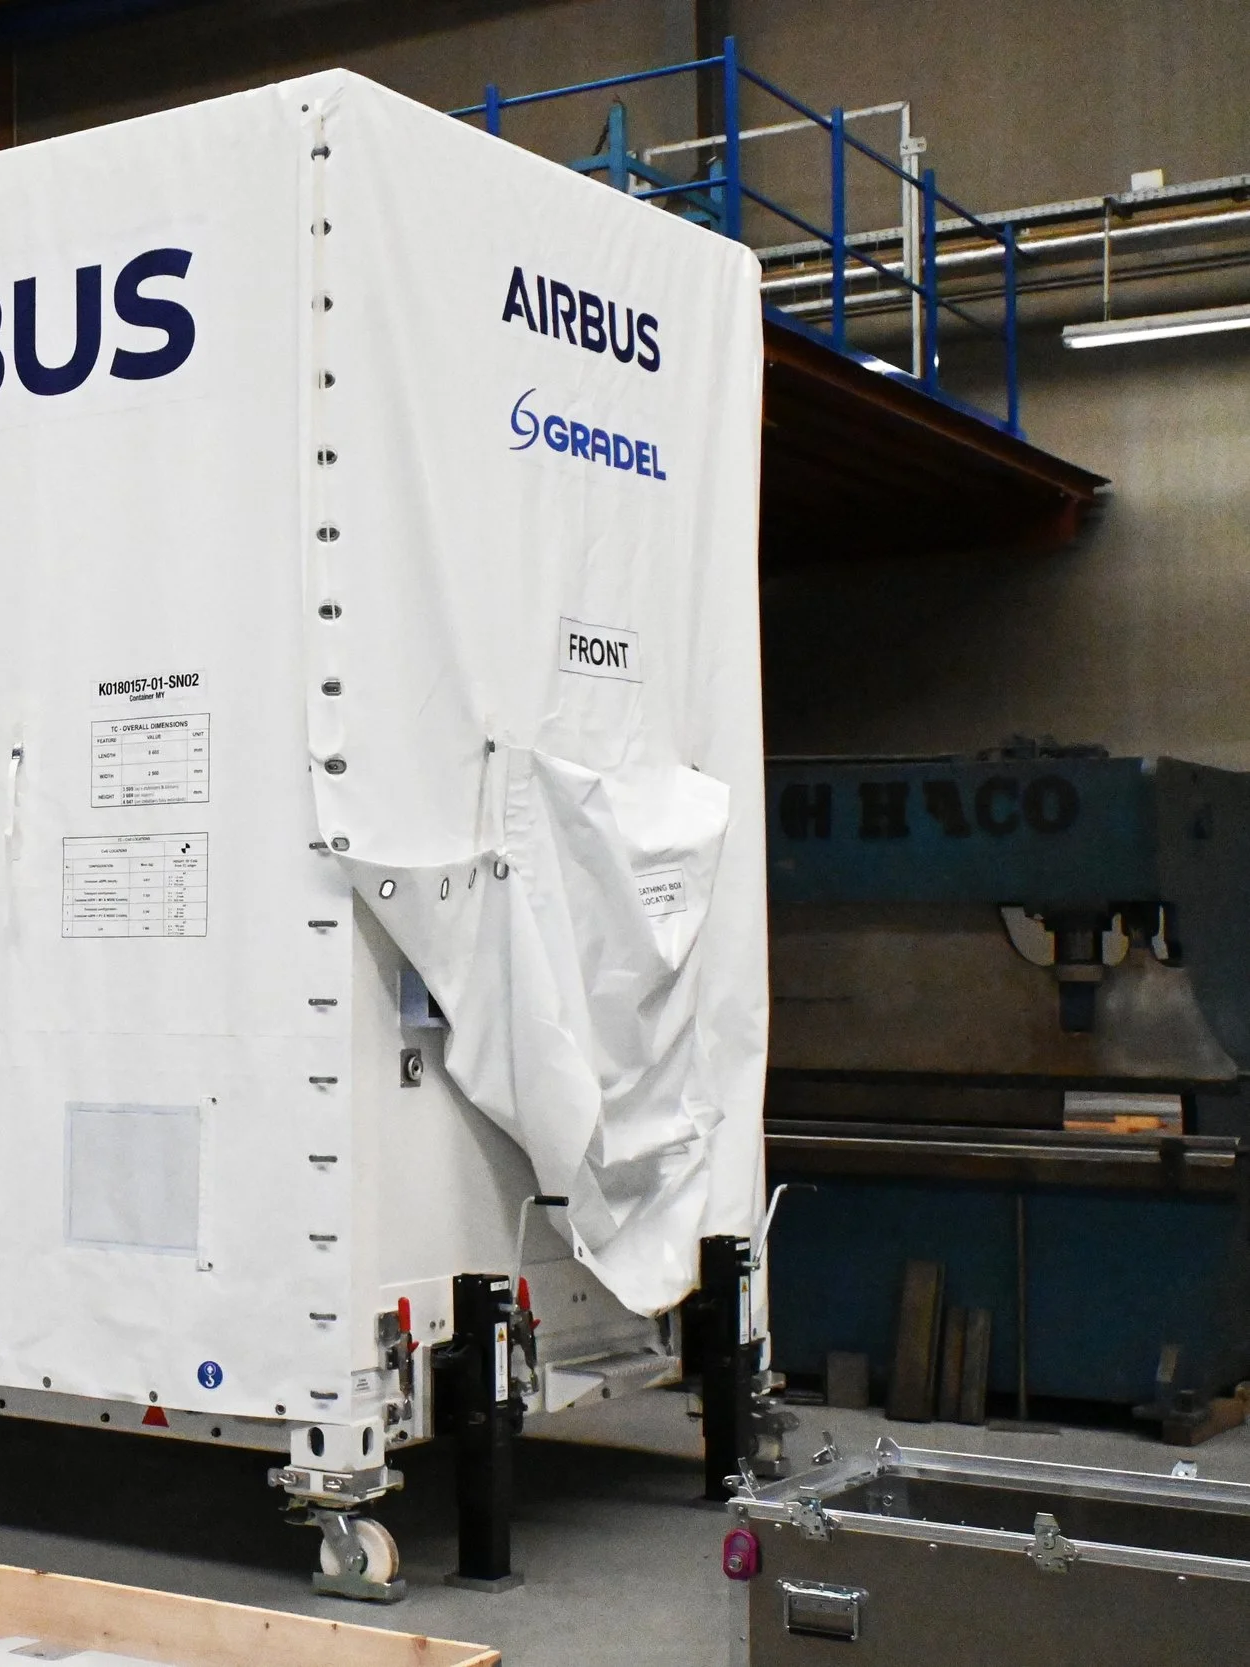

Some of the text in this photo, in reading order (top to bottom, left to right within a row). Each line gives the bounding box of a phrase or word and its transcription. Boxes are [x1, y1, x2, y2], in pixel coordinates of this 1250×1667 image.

[502, 265, 661, 373] AIRBUS
[544, 414, 667, 481] GRADEL
[569, 633, 629, 668] FRONT
[98, 673, 199, 696] K0180157-01-SN02
[129, 691, 165, 702] Container MY
[111, 725, 119, 733] TC
[122, 722, 149, 732] OVERALL
[150, 720, 189, 730] DIMENSIONS
[668, 881, 682, 891] BOX
[642, 894, 675, 905] LOCATION
